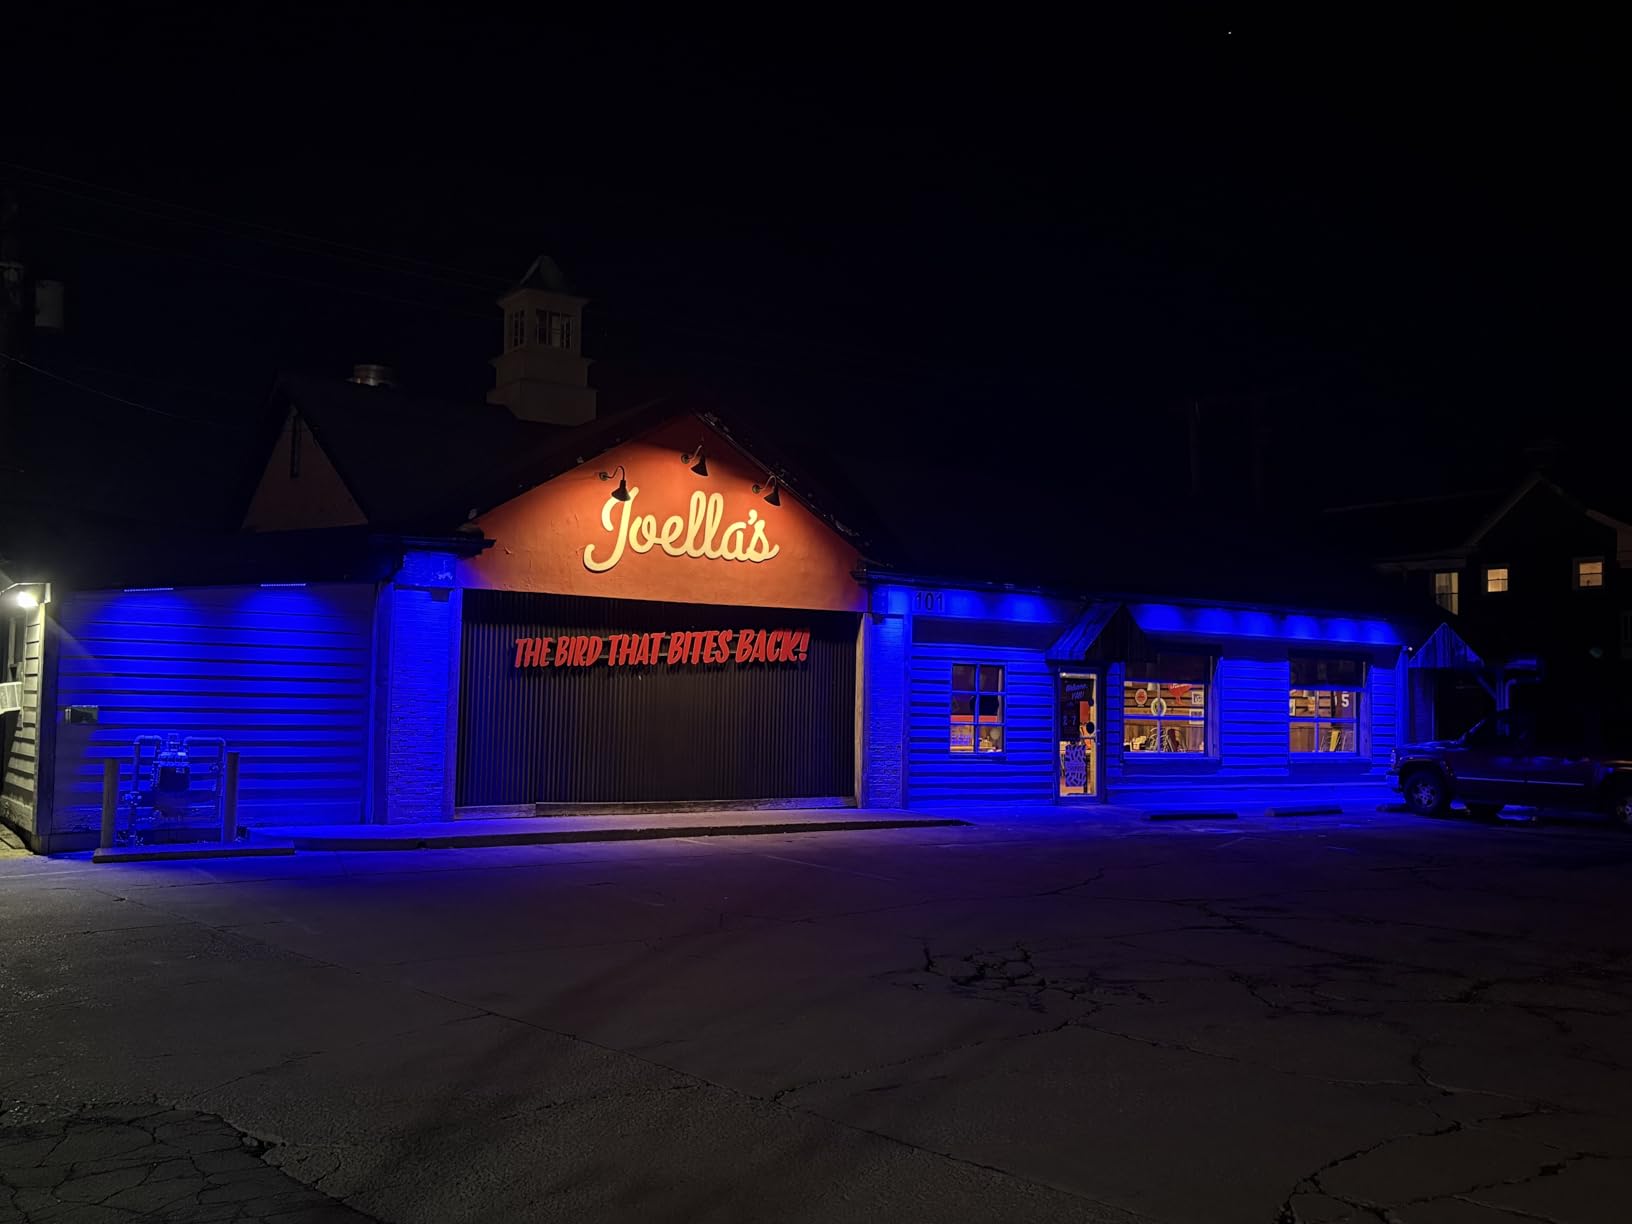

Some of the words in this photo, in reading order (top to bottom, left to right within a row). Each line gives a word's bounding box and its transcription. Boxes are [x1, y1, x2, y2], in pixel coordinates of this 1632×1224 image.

[583, 486, 780, 573] Joella's
[915, 591, 943, 611] 101
[514, 638, 552, 668] THE
[554, 636, 601, 667] BIRD
[608, 632, 665, 666] THAT
[667, 630, 732, 665] BITES
[735, 629, 810, 663] BACK!
